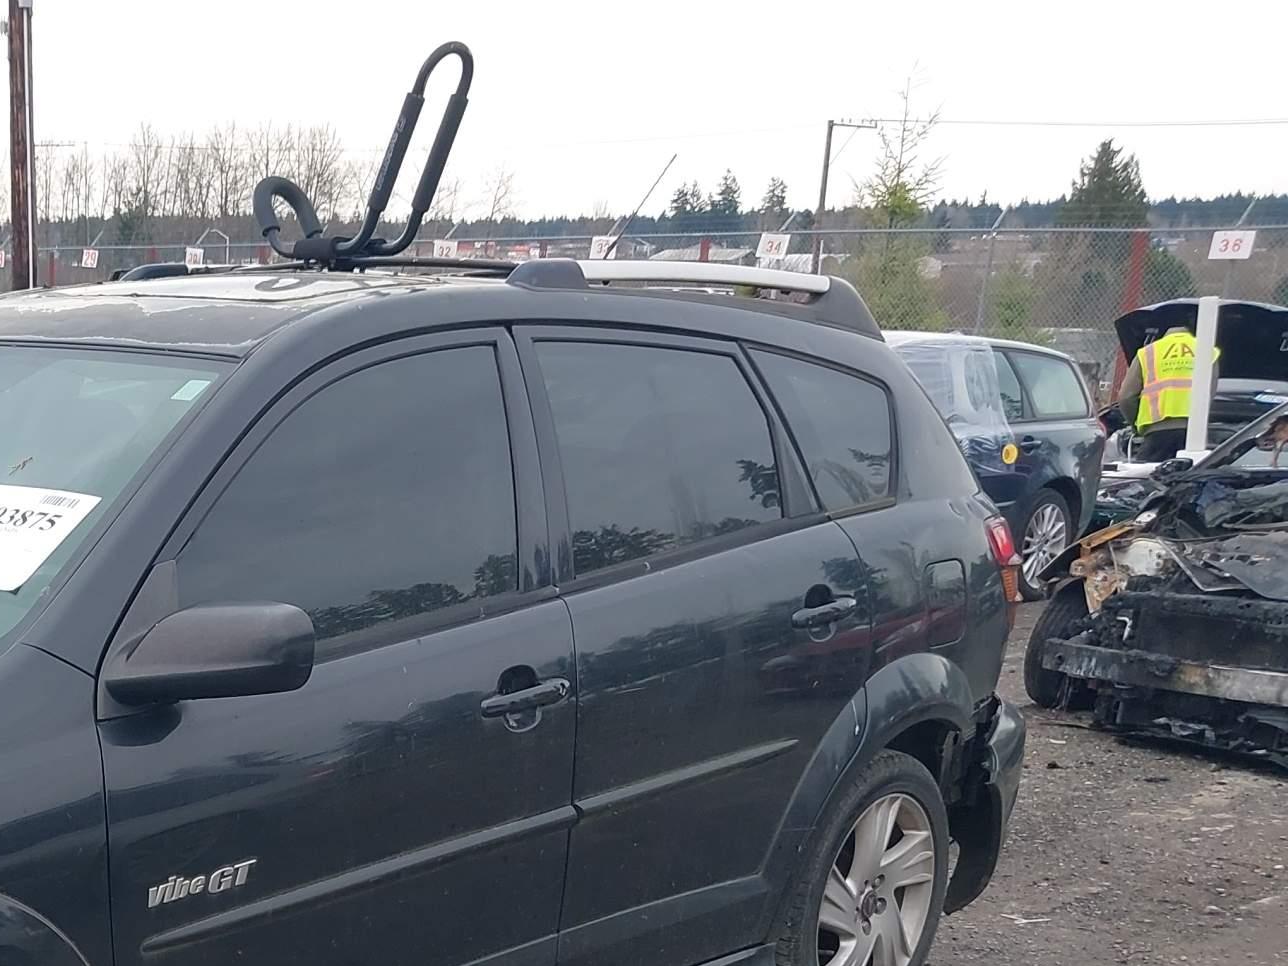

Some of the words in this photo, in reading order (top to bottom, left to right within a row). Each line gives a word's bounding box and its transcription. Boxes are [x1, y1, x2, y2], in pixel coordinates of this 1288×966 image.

[438, 246, 451, 258] 32
[766, 239, 782, 254] 34
[1218, 238, 1244, 253] 36
[83, 251, 97, 266] 29
[207, 858, 258, 894] GT
